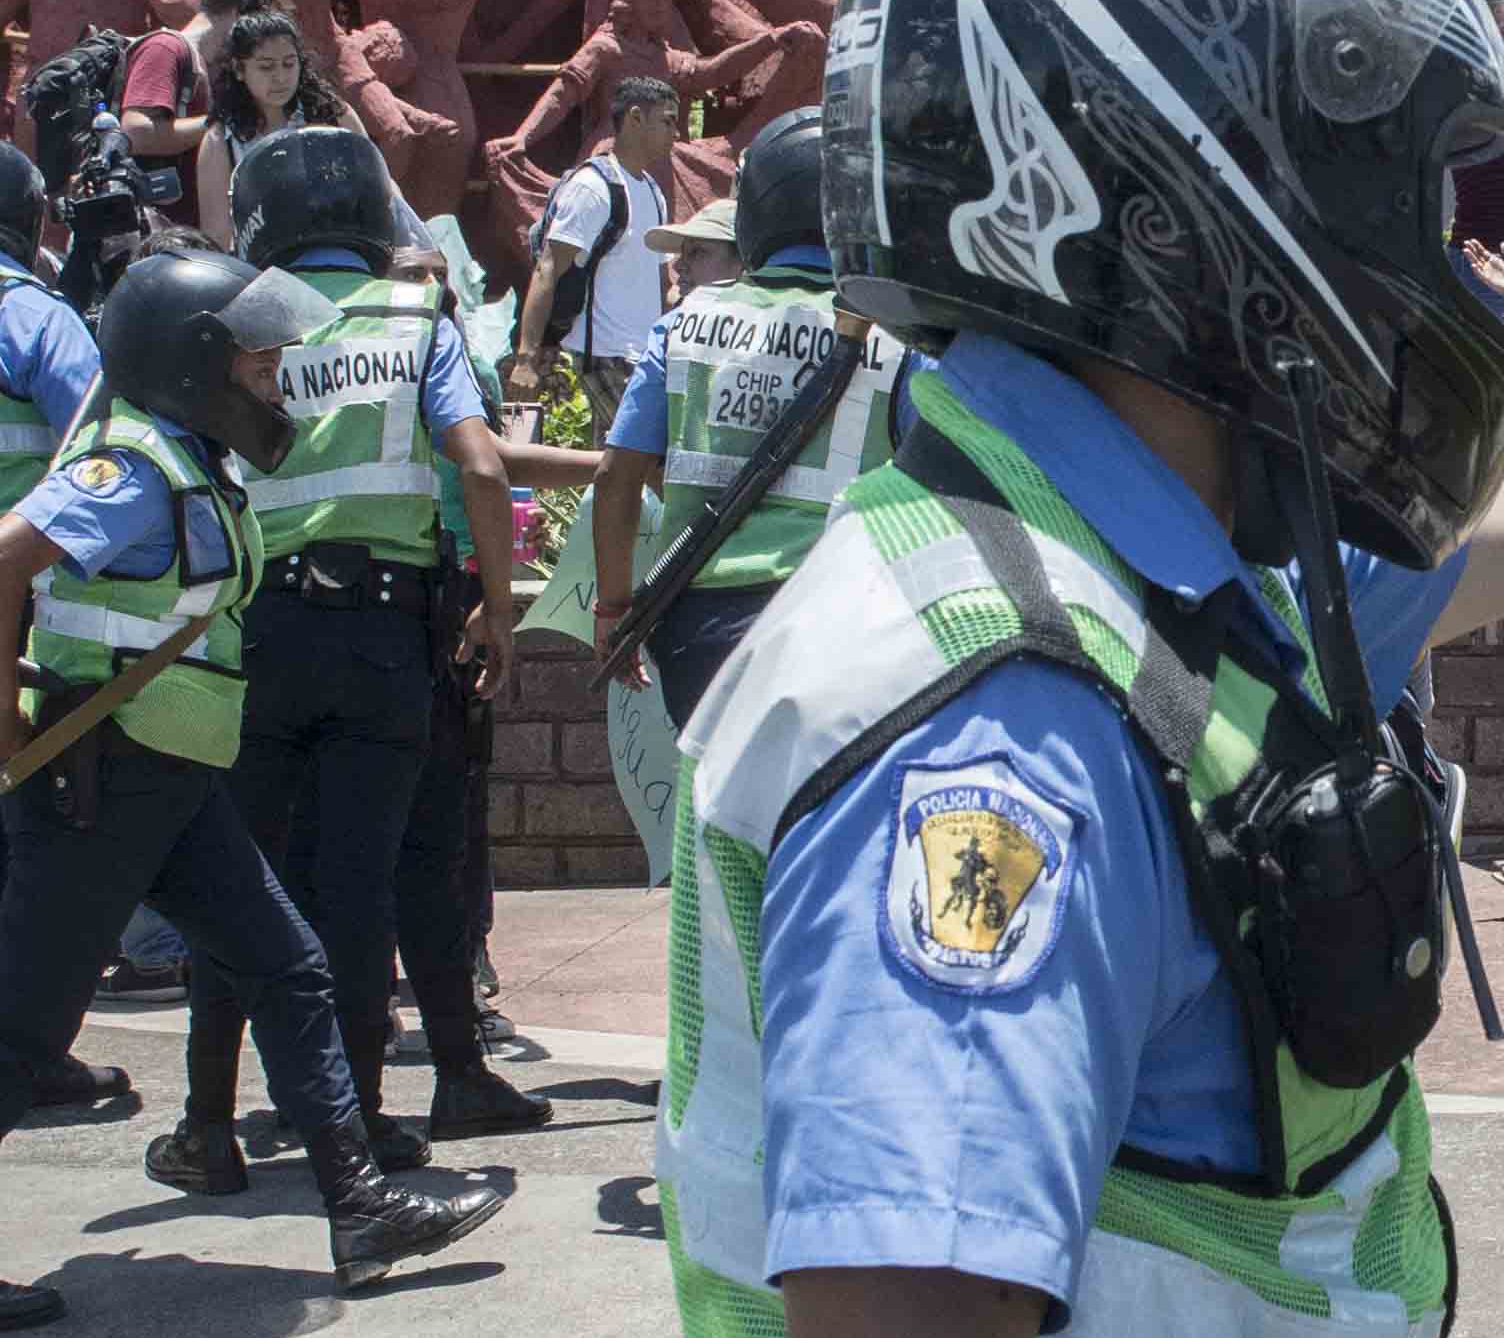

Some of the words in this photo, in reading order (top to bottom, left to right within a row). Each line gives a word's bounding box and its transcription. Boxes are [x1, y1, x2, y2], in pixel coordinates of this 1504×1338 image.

[670, 311, 758, 353] POLICIA
[301, 349, 420, 401] NACIONAL
[736, 370, 784, 395] CHIP
[917, 790, 982, 818] POLICIA
